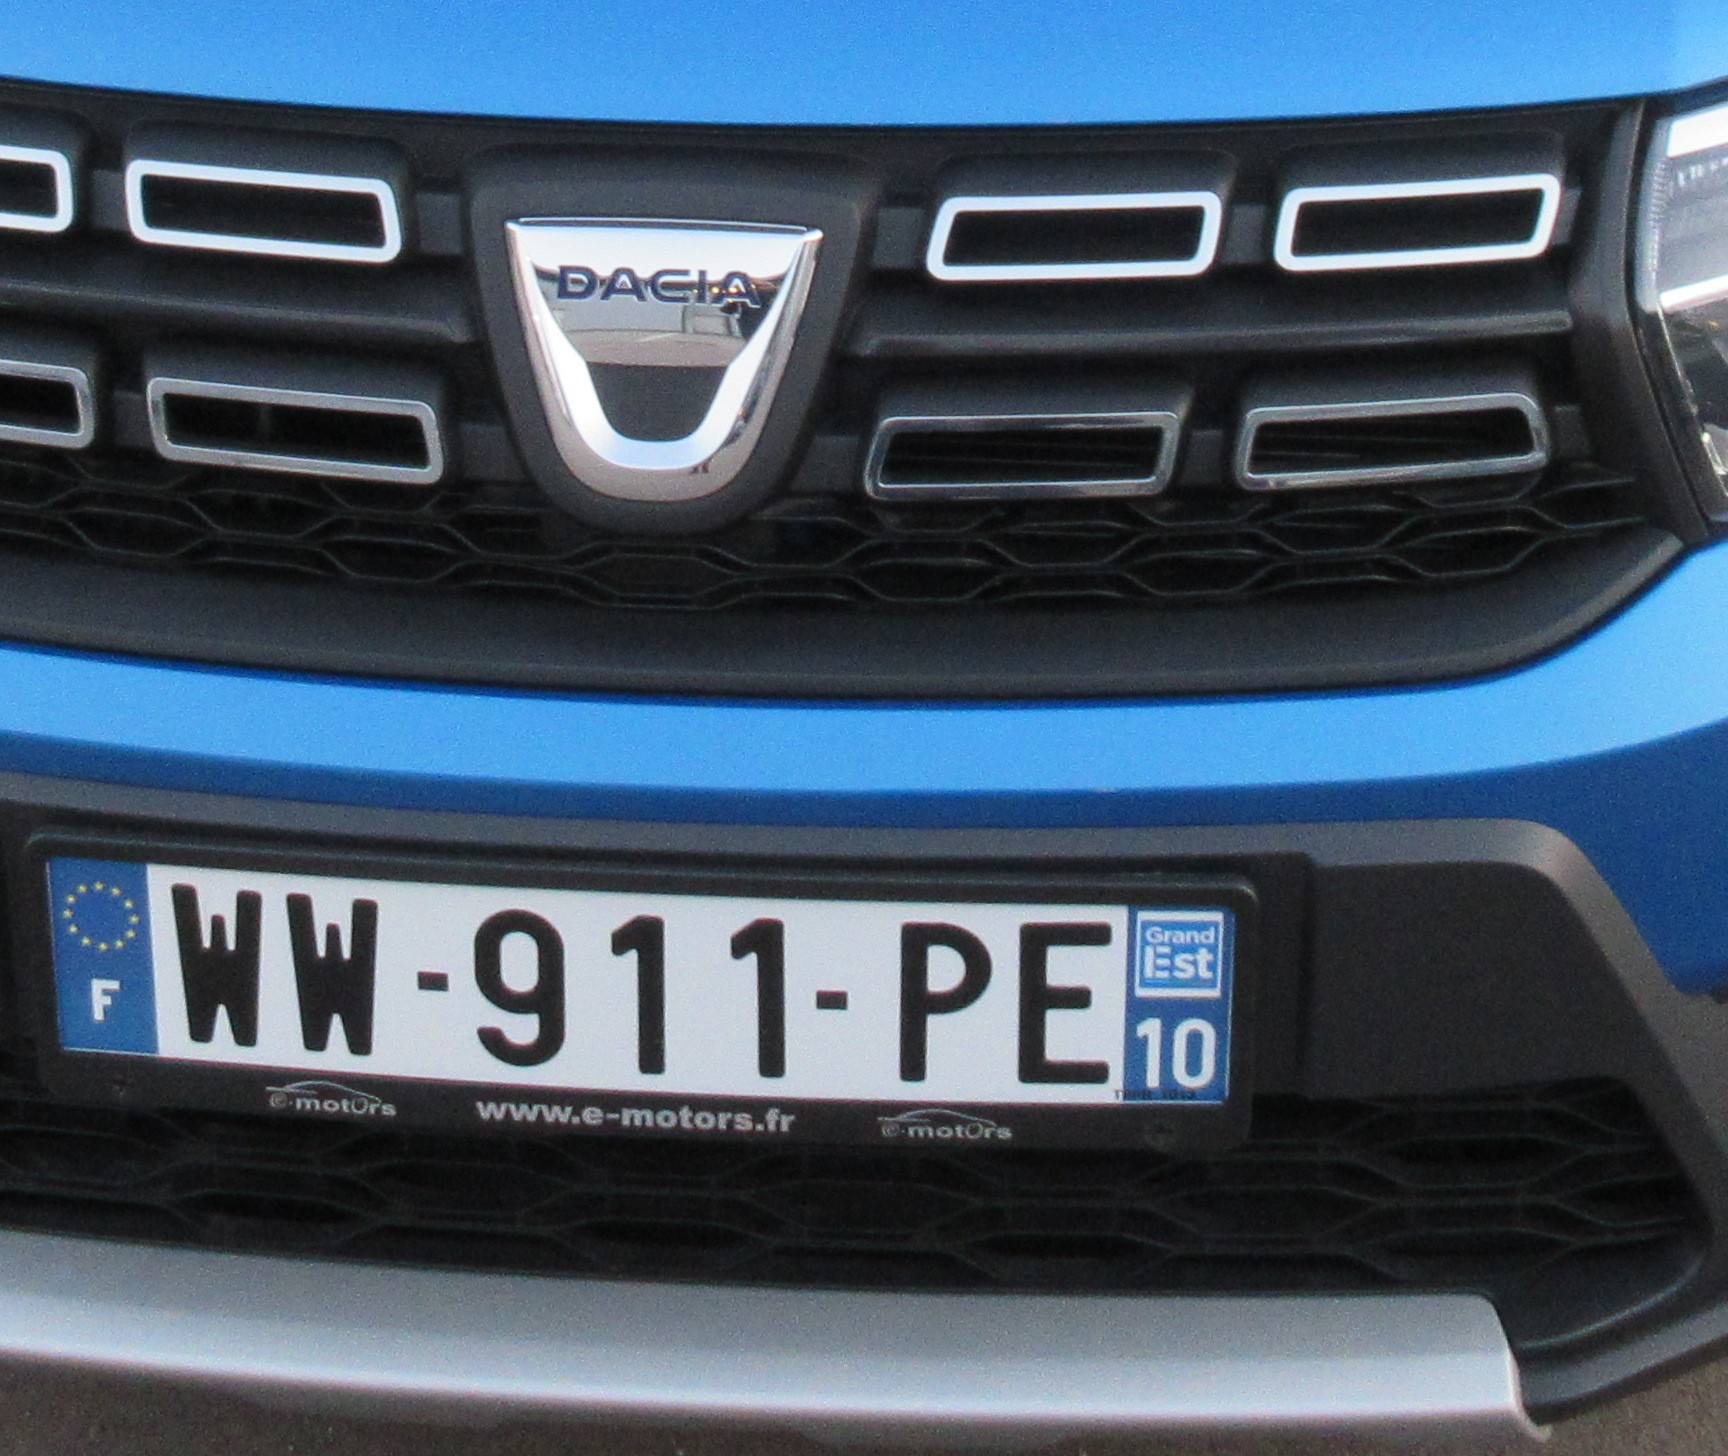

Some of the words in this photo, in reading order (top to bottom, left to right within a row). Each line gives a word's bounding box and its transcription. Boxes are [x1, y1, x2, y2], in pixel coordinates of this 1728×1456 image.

[556, 265, 761, 308] DACIA
[1145, 926, 1216, 944] Grand
[1144, 945, 1215, 979] Est
[90, 978, 121, 1022] F
[171, 883, 1113, 1085] WW-911-PE
[1135, 1017, 1217, 1089] 10
[474, 1099, 797, 1133] www.e-motors.fr
